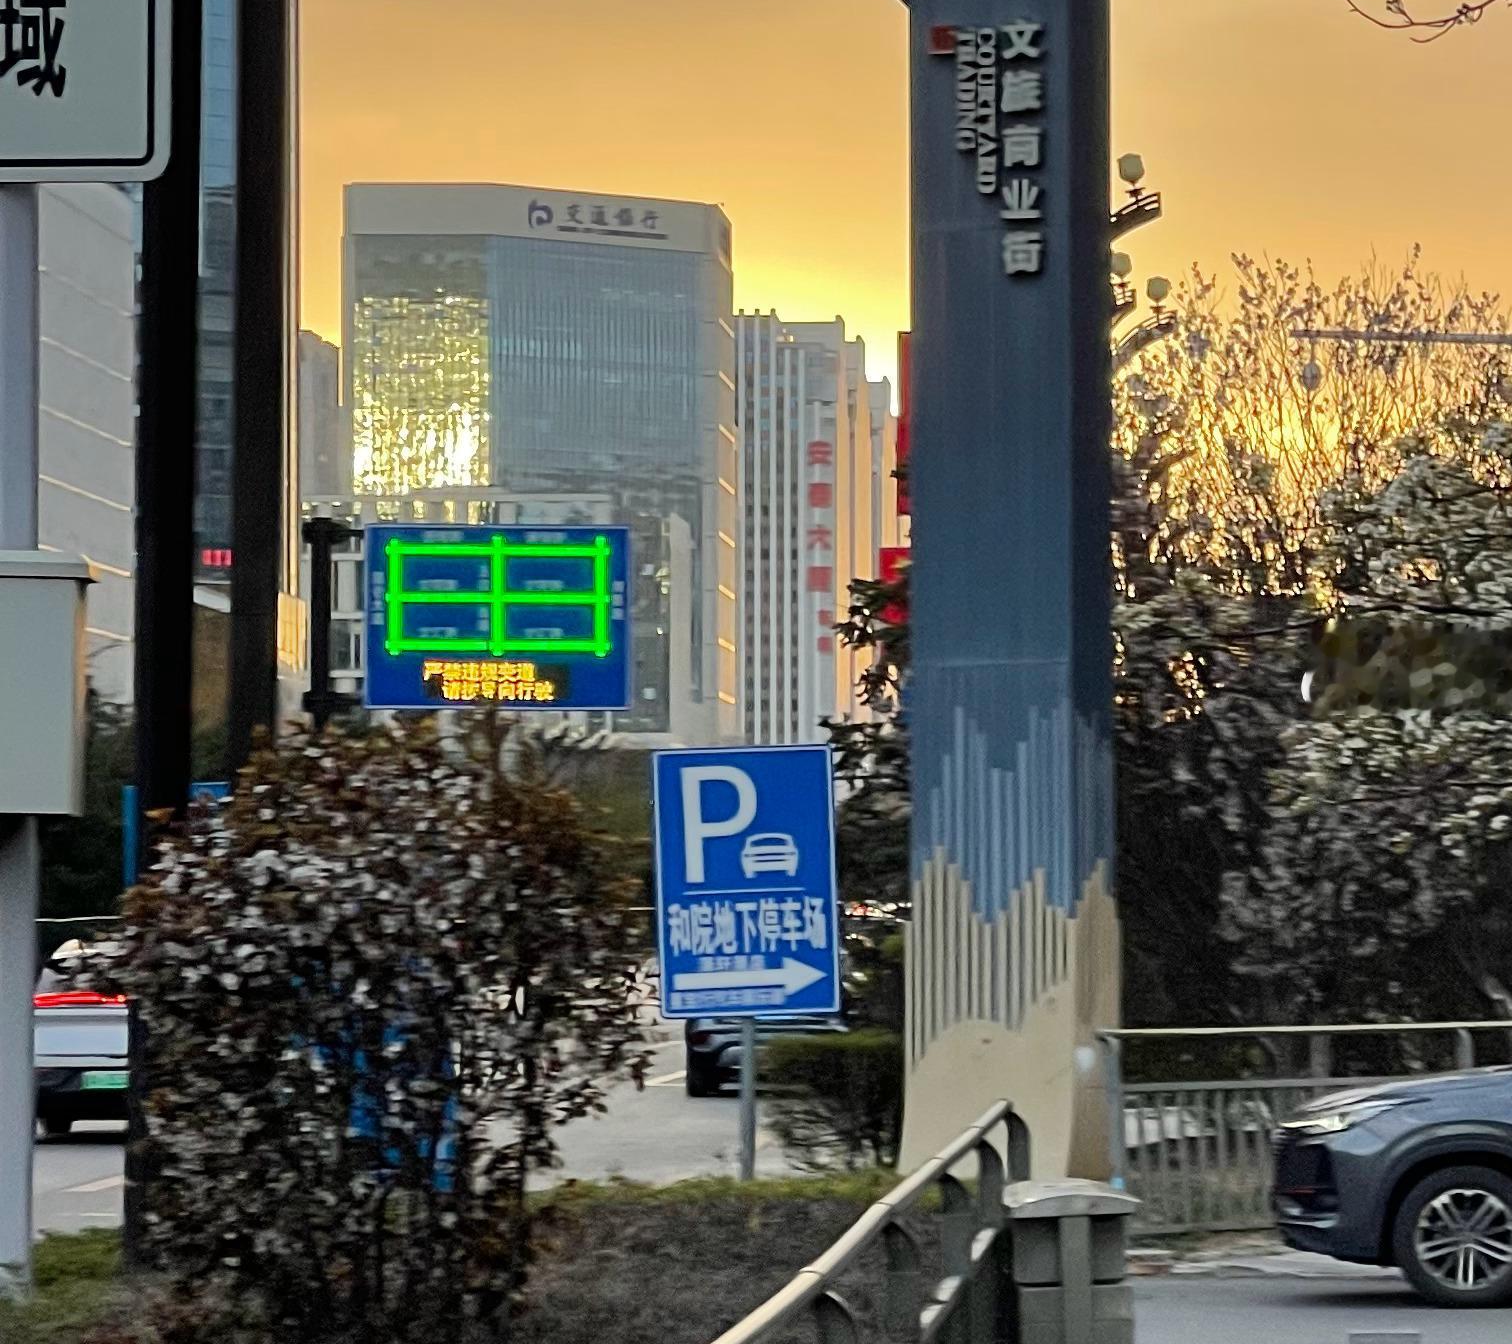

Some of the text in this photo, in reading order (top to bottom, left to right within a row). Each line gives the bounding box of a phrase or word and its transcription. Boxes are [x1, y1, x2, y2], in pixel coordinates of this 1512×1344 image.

[680, 765, 758, 883] P
[668, 896, 828, 956] 和院地下停车场
